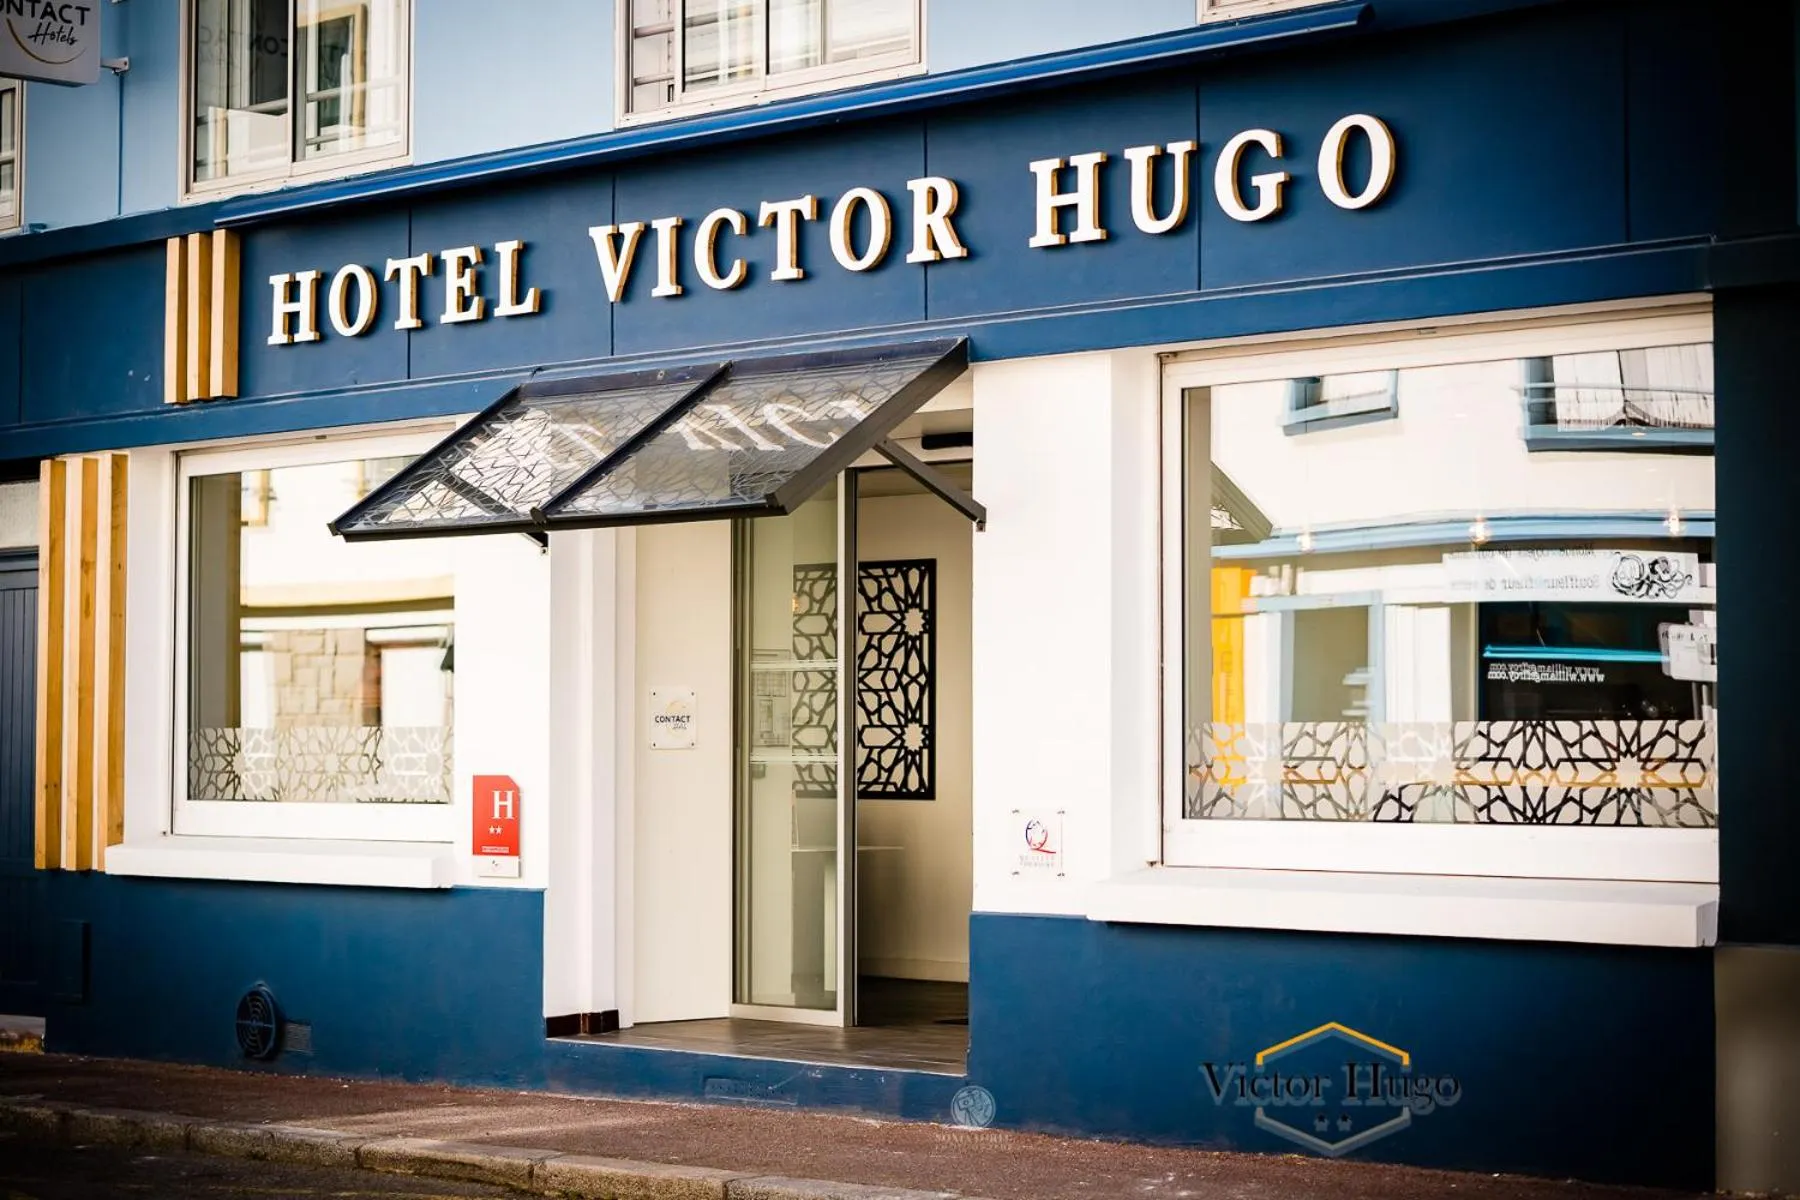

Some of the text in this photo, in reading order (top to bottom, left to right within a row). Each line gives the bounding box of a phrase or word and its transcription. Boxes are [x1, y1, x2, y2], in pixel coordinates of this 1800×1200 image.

[0, 0, 91, 26] NTACT
[28, 22, 78, 46] Hotels
[267, 114, 1396, 345] HOTEL VICTOR HUGO
[654, 715, 691, 724] CONTACT
[491, 790, 515, 819] H
